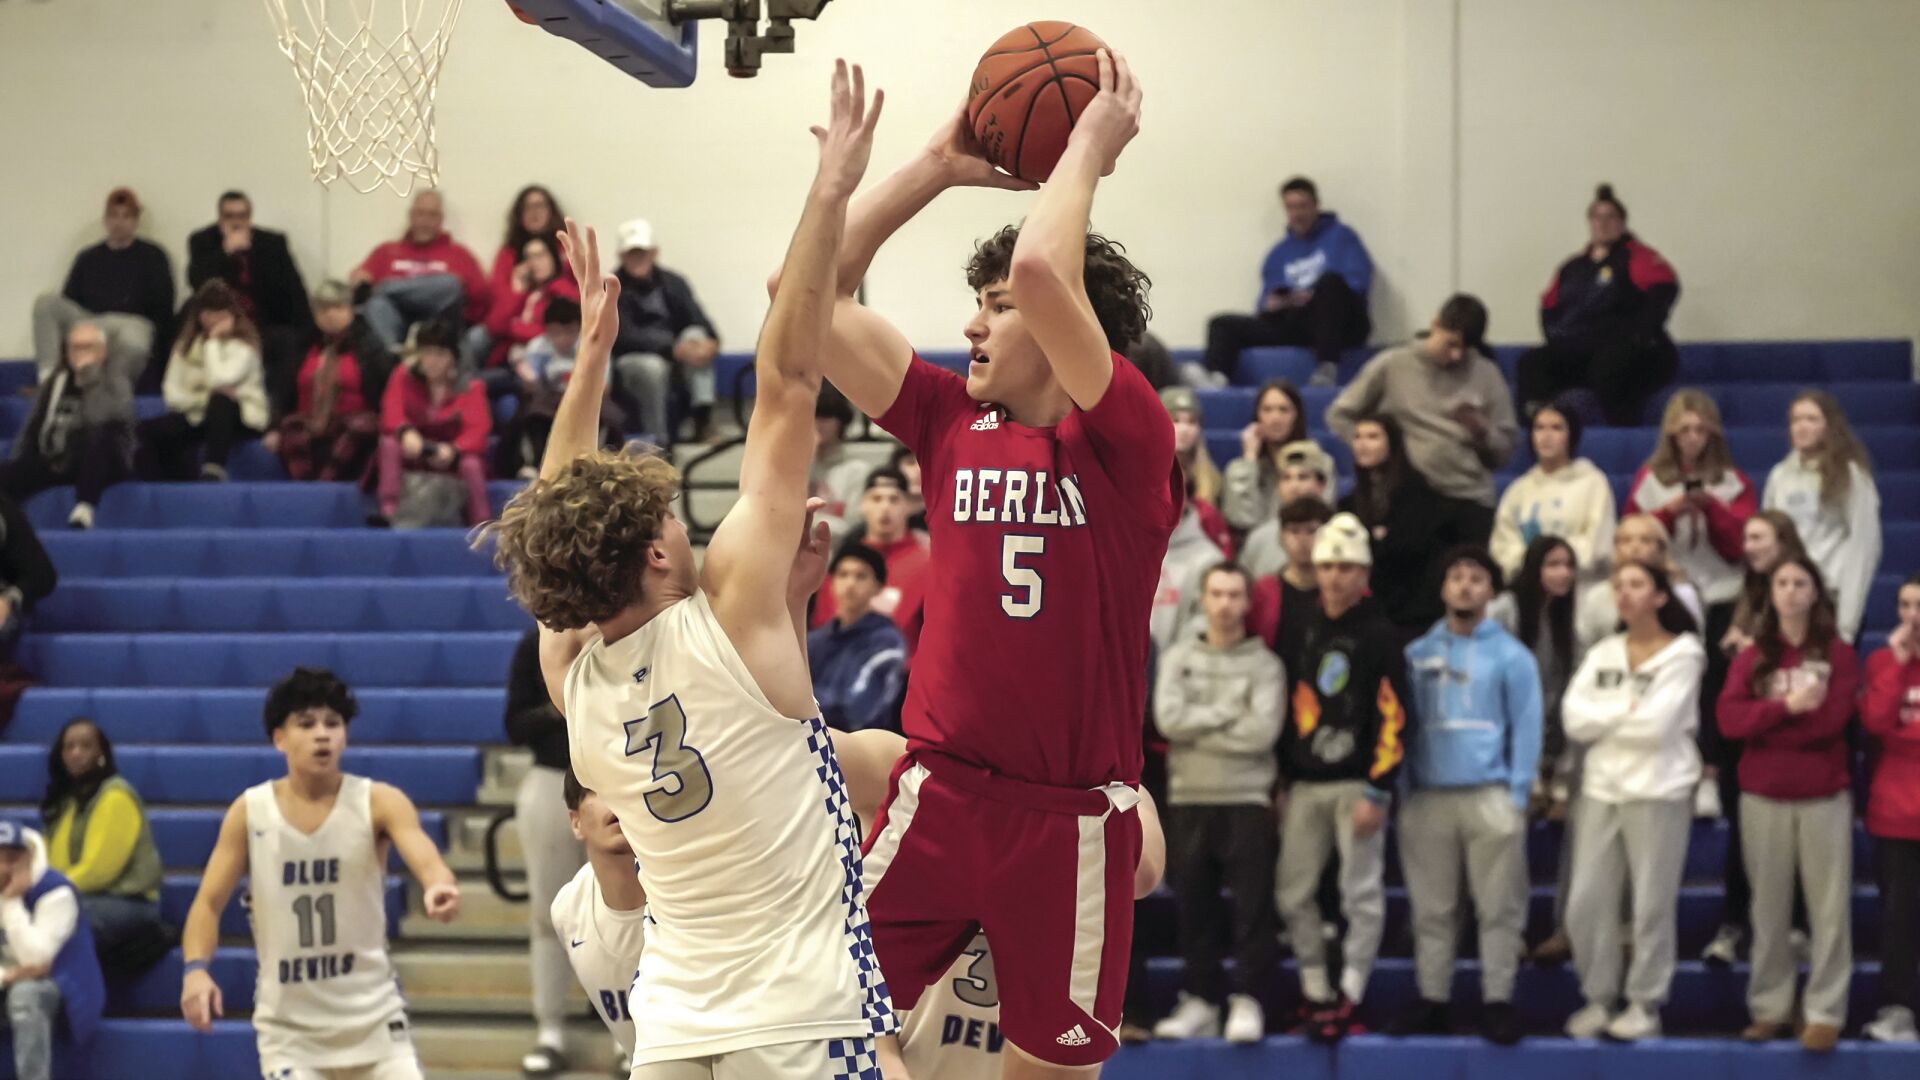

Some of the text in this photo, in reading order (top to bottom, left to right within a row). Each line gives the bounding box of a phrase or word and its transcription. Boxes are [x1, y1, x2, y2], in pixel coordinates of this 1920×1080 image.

[970, 421, 1000, 431] adidas
[953, 468, 1087, 526] BERLIN
[1001, 534, 1045, 618] 5
[623, 692, 713, 823] 3
[283, 858, 338, 886] BLUE
[292, 893, 336, 948] 11
[278, 952, 355, 984] DEVILS
[953, 932, 999, 1008] 3
[1056, 1036, 1091, 1046] adidas
